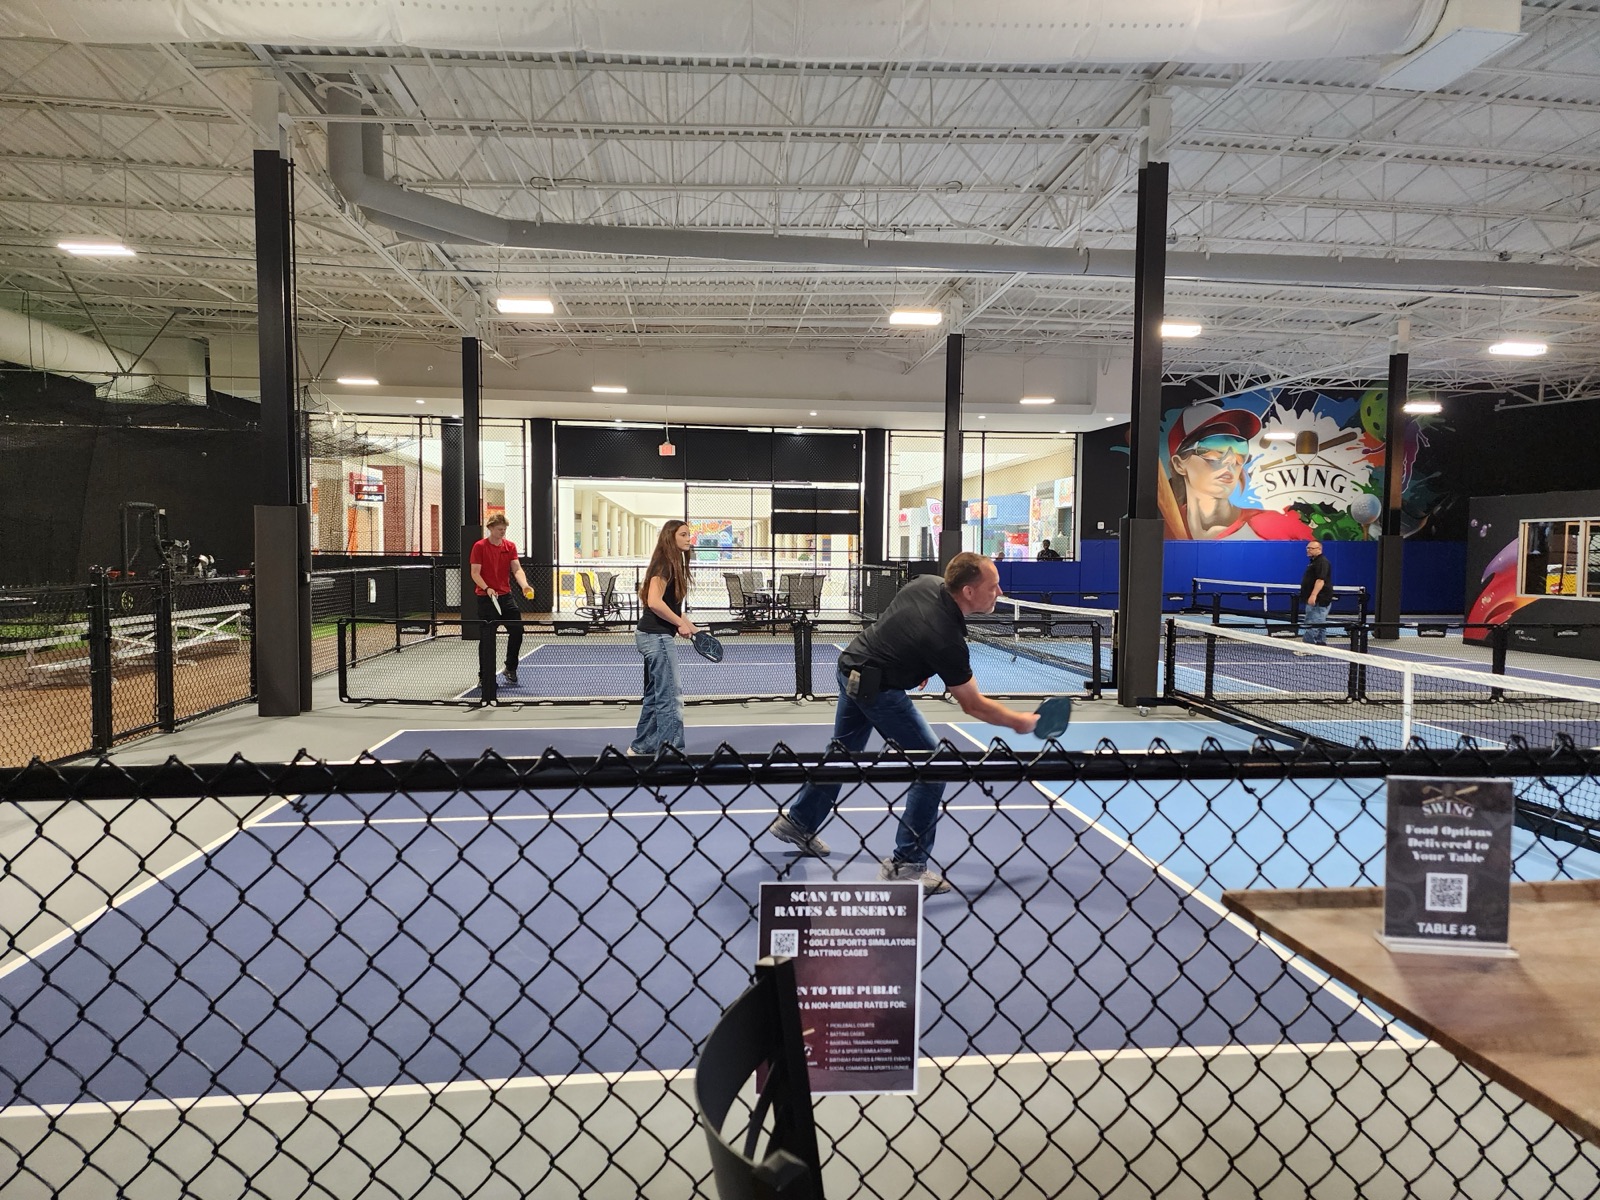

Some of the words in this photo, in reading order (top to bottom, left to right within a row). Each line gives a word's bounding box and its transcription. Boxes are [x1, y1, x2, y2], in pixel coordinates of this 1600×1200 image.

[1264, 465, 1347, 493] SWING
[1422, 801, 1475, 818] SWING
[1405, 824, 1439, 835] Food
[1441, 826, 1493, 838] Options
[1407, 837, 1472, 850] Delivered
[1474, 842, 1490, 851] to
[1411, 850, 1445, 861] Your
[1447, 852, 1485, 863] Table
[790, 891, 828, 902] SCAN
[830, 891, 852, 902] TO
[854, 891, 892, 902] VIEW
[774, 905, 823, 917] RATES
[825, 905, 838, 917] &
[841, 905, 907, 917] RESERVE
[809, 928, 854, 936] PICKLEBALL
[855, 928, 886, 936] COURTS
[1416, 922, 1458, 935] TABLE
[1460, 924, 1477, 936] #2
[808, 939, 829, 947] GOLF
[837, 938, 867, 946] SPORTS
[868, 938, 916, 946] SIMULATORS
[808, 949, 842, 957] BATTING
[843, 949, 869, 957] CAGES
[810, 986, 828, 996] TO
[830, 986, 855, 995] THE
[856, 985, 901, 995] PUBLIC
[811, 1001, 863, 1009] NON-MEMBER
[864, 1001, 889, 1009] RATES
[889, 1000, 907, 1008] FOR:
